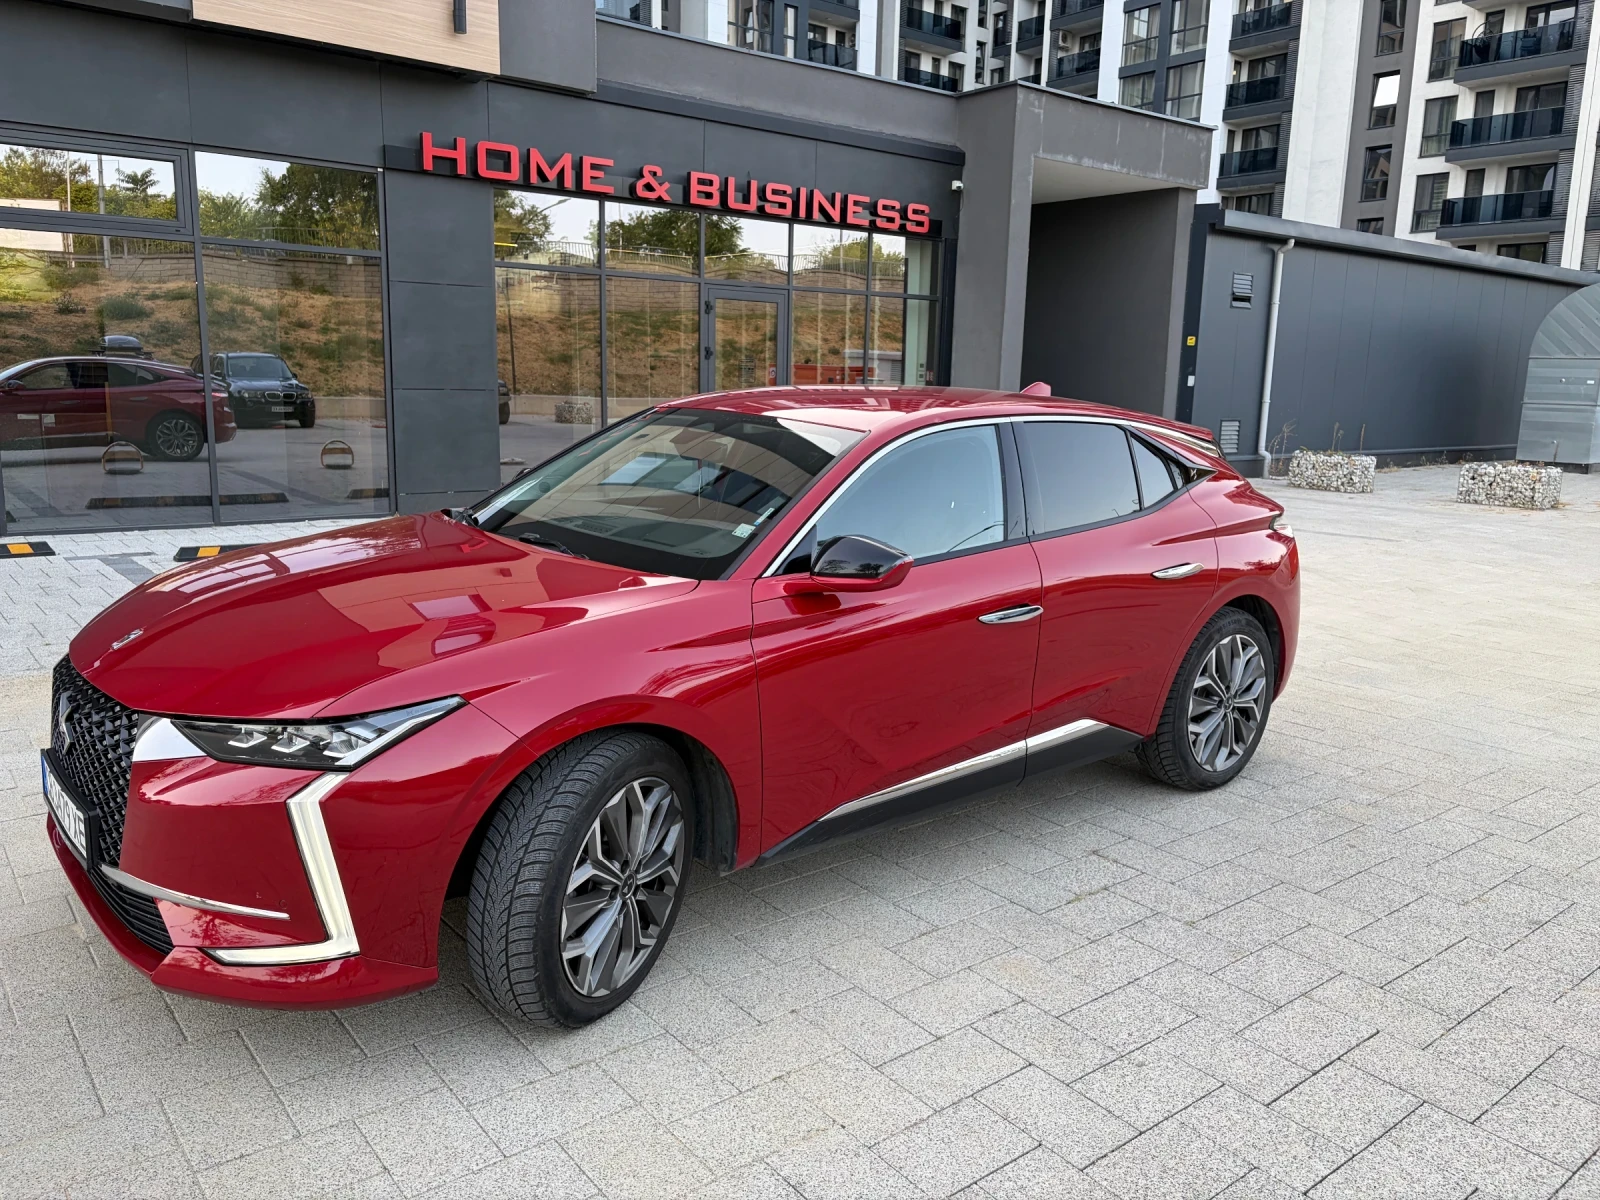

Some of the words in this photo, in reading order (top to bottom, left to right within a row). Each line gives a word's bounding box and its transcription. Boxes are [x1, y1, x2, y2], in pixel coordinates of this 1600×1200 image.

[420, 132, 615, 194] HOME
[635, 165, 671, 201] &
[687, 170, 930, 233] BUSINESS
